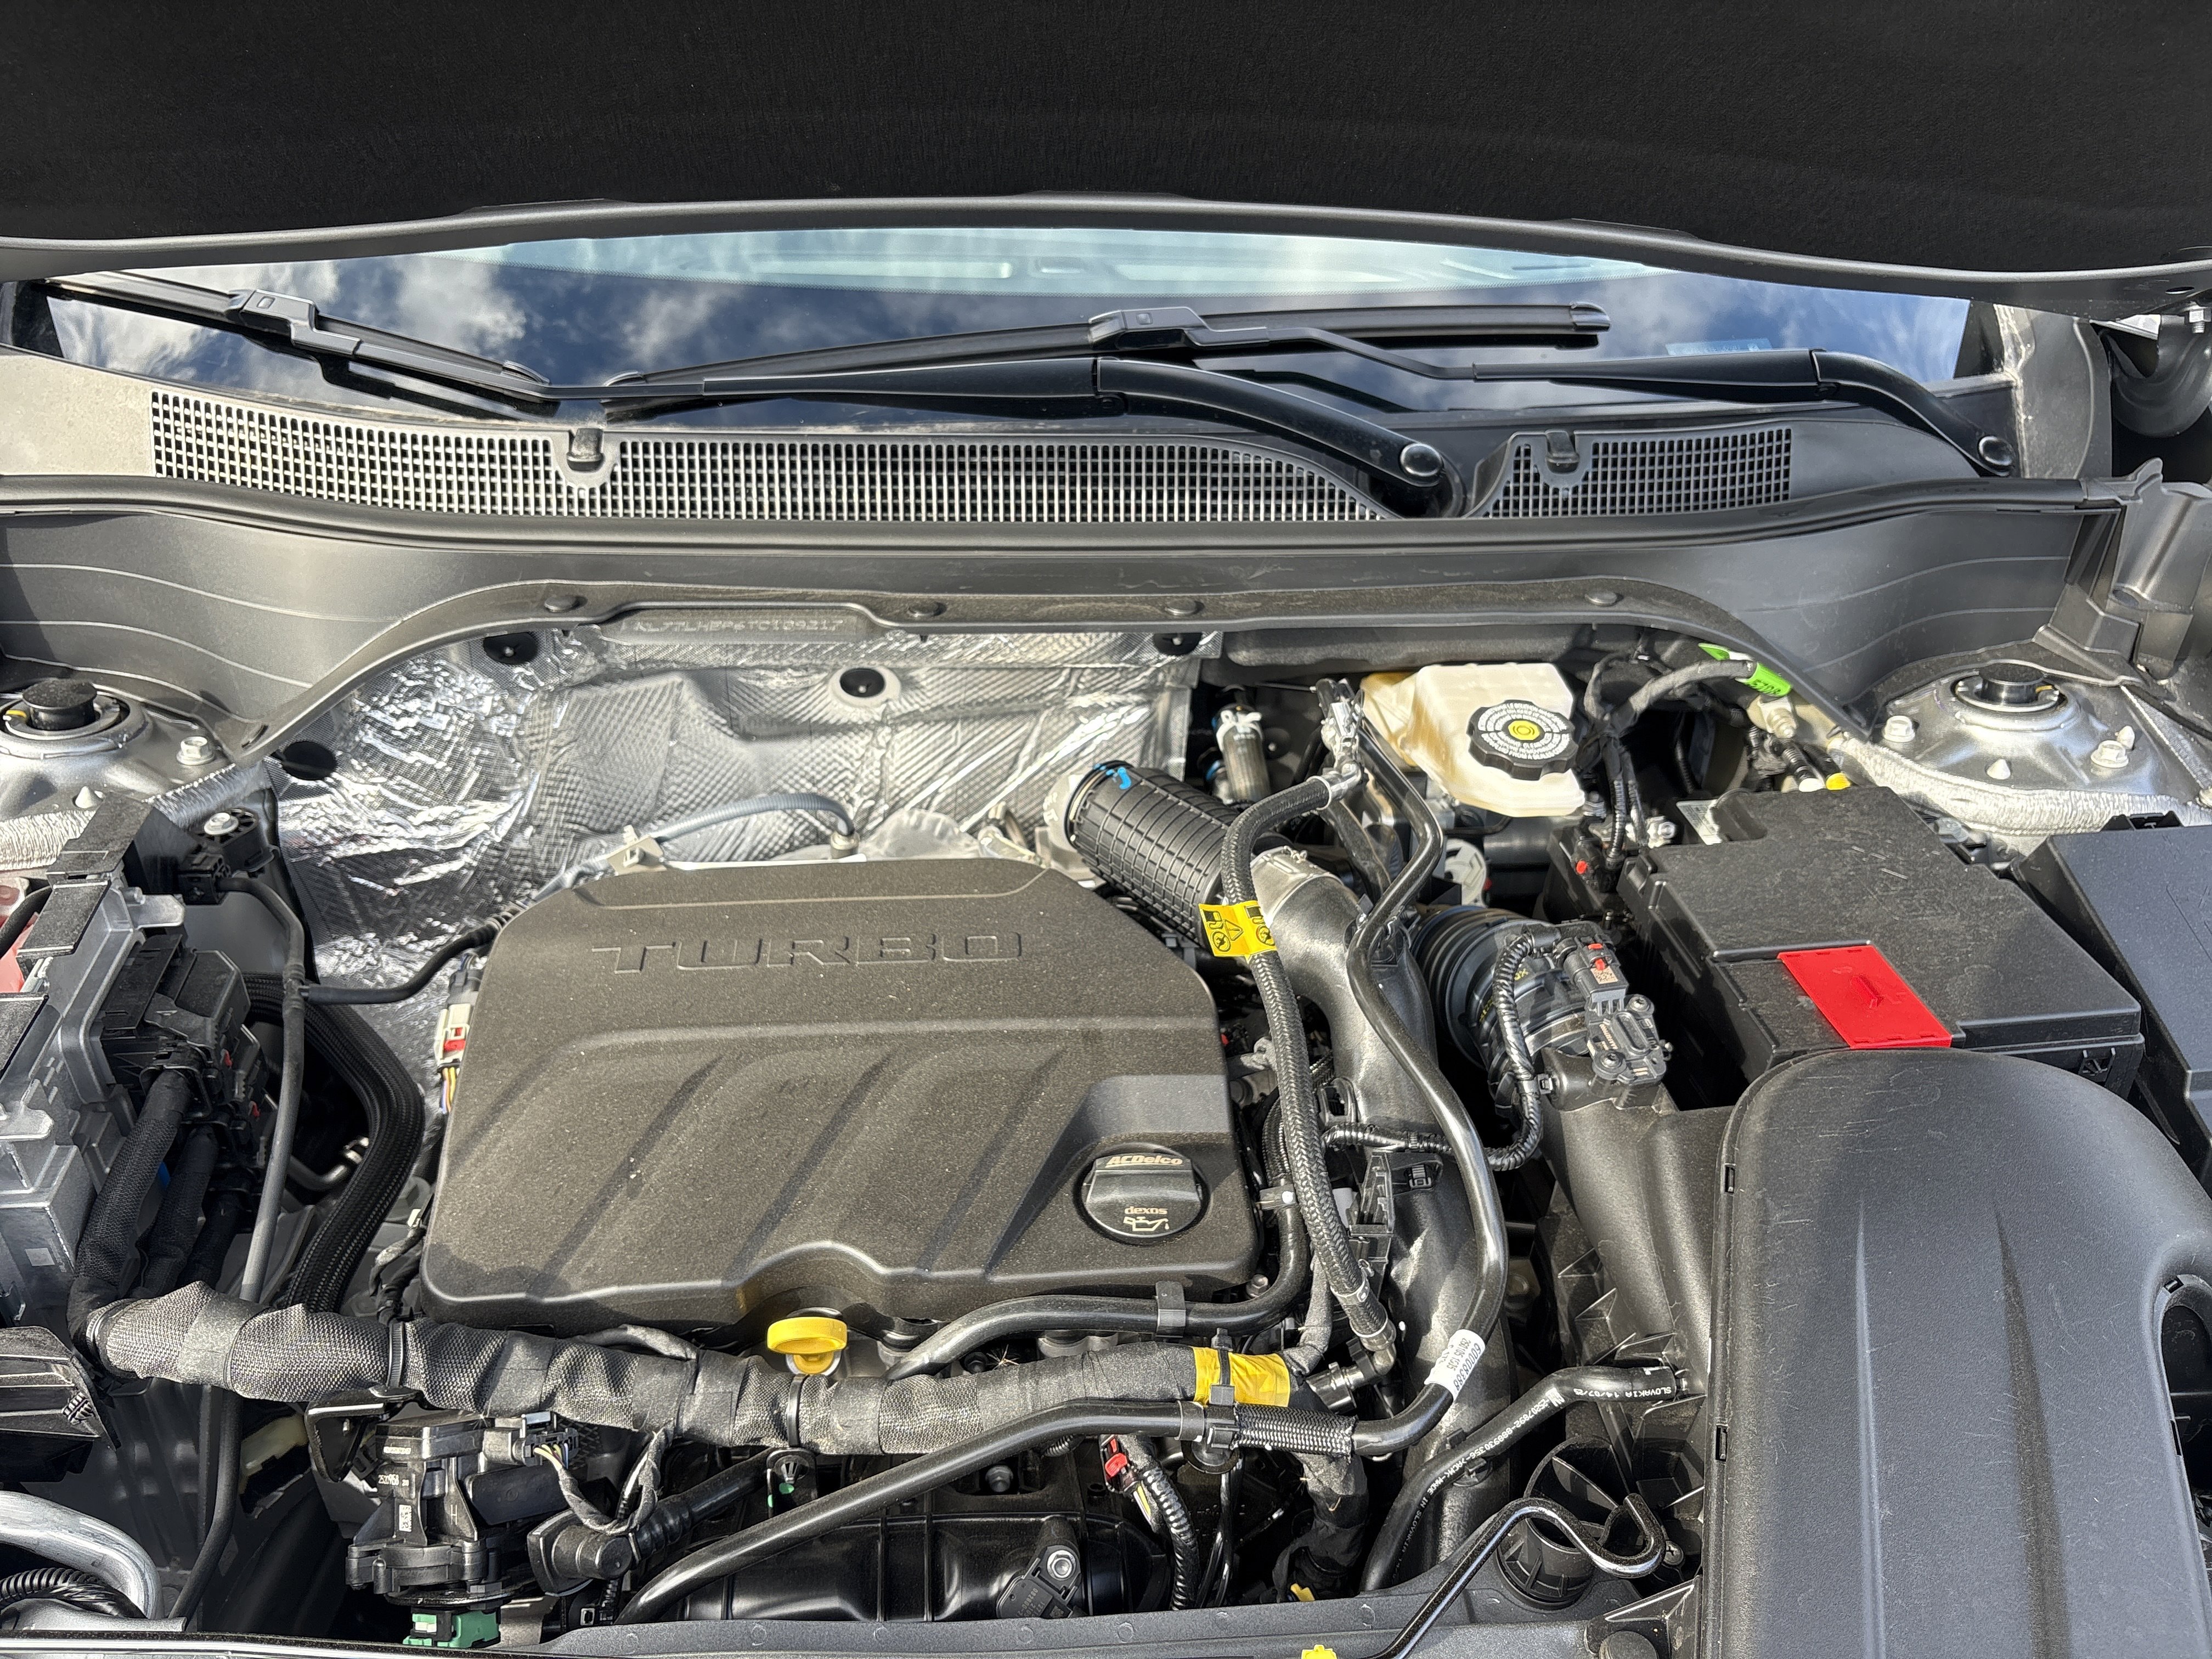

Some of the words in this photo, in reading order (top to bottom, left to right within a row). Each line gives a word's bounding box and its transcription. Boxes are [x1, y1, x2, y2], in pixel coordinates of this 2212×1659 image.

[591, 932, 1023, 974] TURBO
[1106, 1155, 1183, 1166] ACDelco
[1124, 1206, 1169, 1215] dexos
[1453, 1342, 1482, 1391] 60008388
[1625, 1386, 1672, 1398] SLOVAKIA
